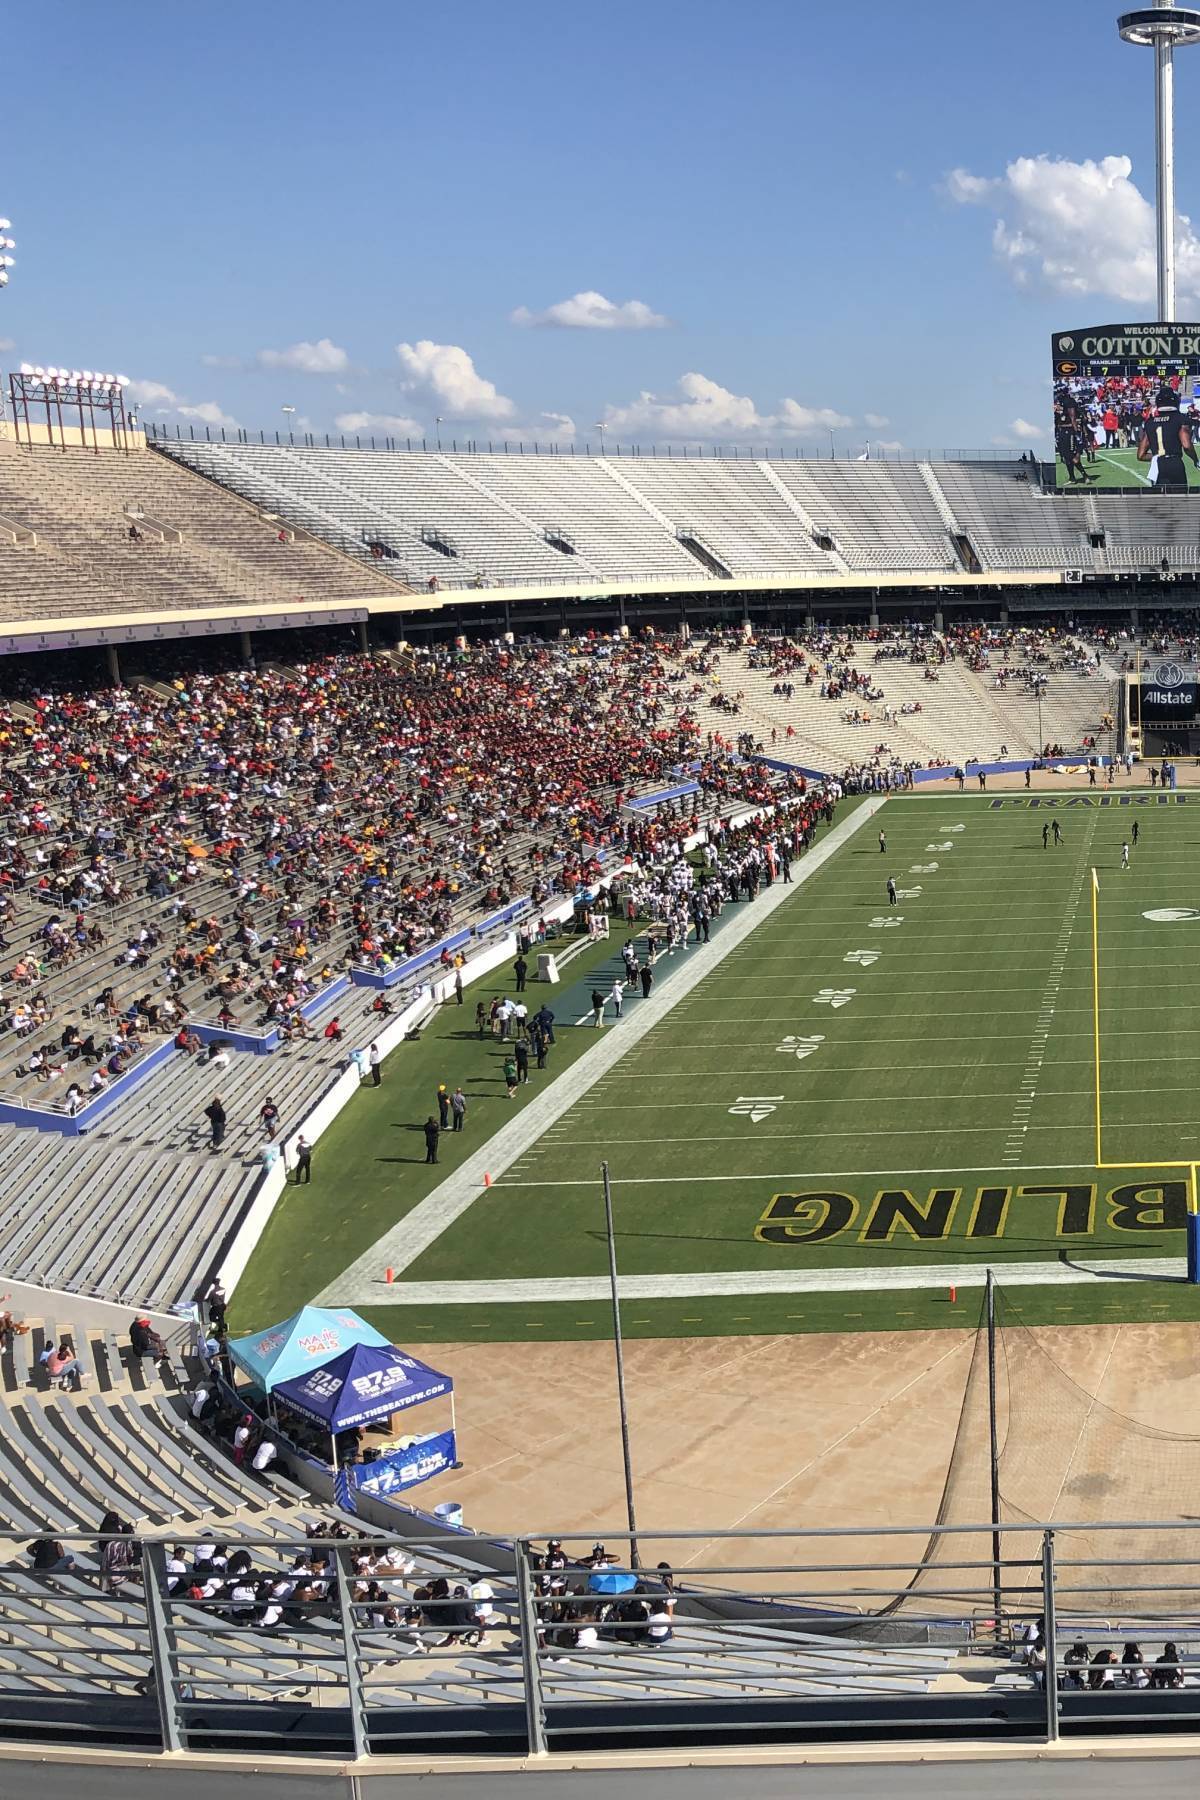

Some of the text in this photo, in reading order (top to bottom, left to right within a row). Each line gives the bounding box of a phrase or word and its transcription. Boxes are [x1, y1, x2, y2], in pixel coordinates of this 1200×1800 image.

[1124, 326, 1169, 335] WELCOME
[1170, 326, 1183, 334] TO
[1081, 336, 1173, 356] COTTON
[1102, 367, 1109, 376] 7
[1155, 426, 1166, 457] 1
[1143, 691, 1193, 704] Allstate
[728, 1095, 785, 1115] 10
[298, 1328, 340, 1347] MAJIC
[306, 1341, 339, 1355] 94.5
[311, 1370, 344, 1392] 97.9
[352, 1366, 405, 1392] 97.9
[336, 1383, 446, 1428] WWW.THEBEATDFW.COM
